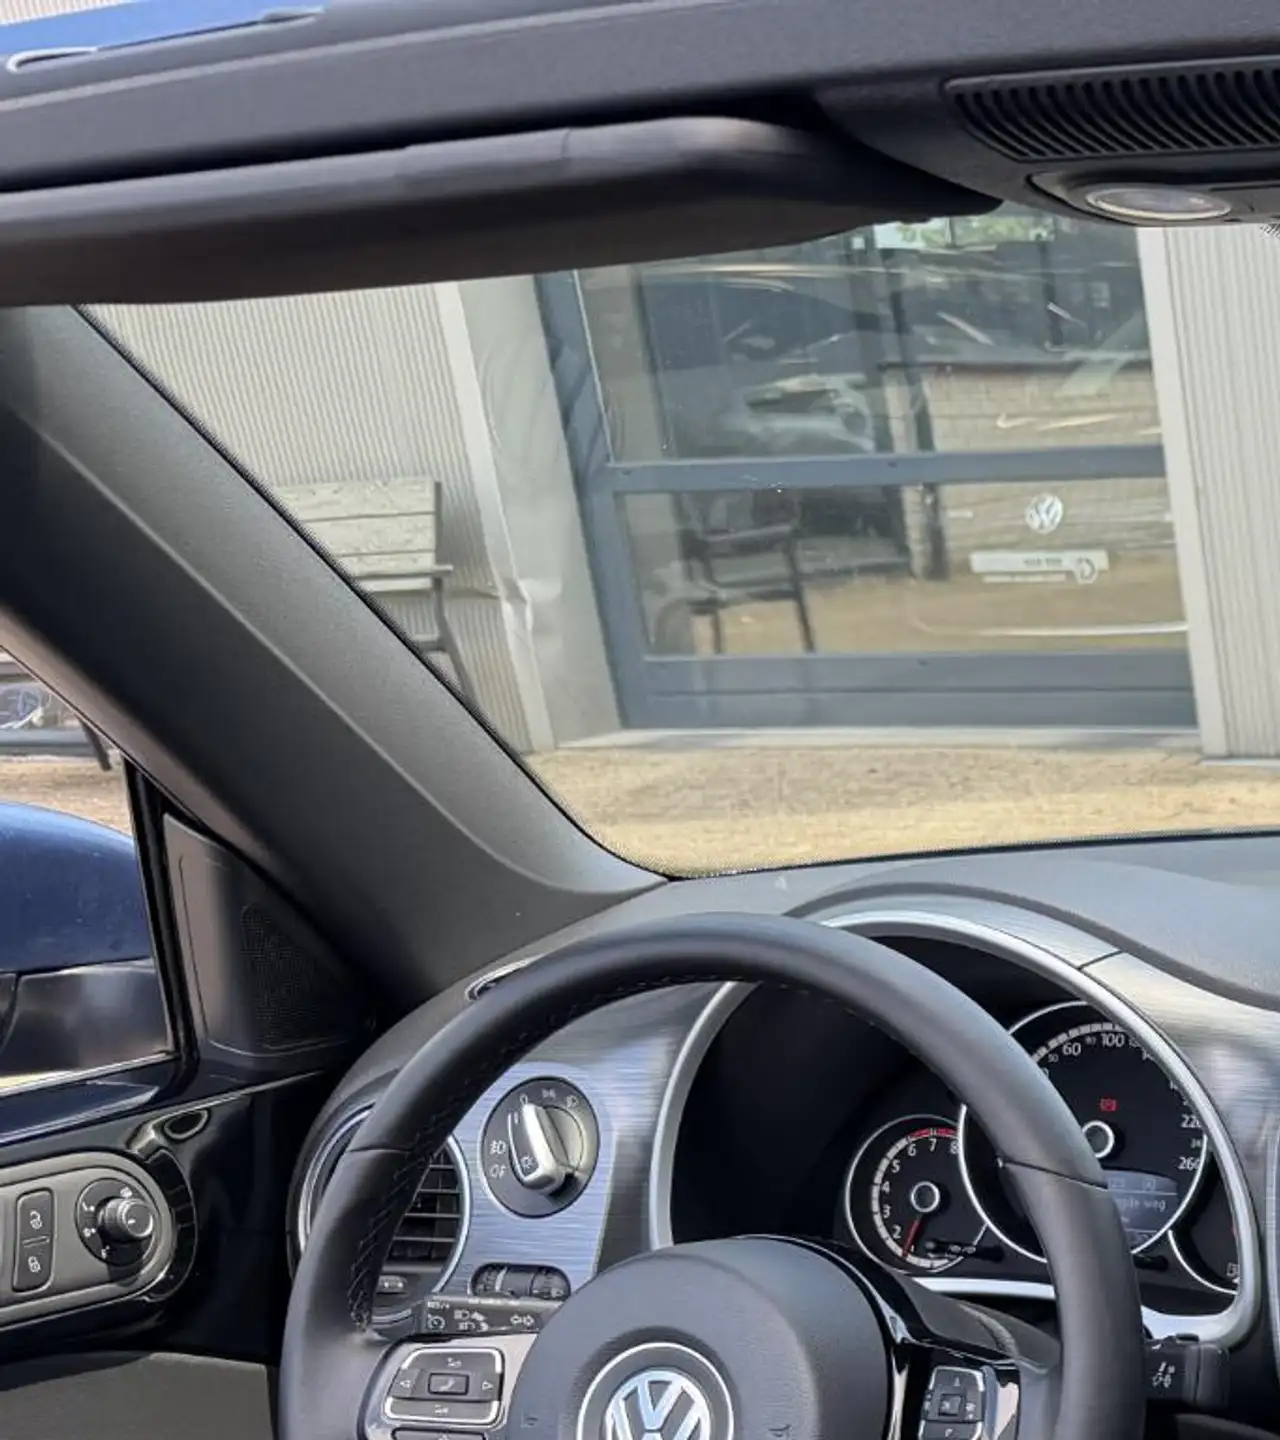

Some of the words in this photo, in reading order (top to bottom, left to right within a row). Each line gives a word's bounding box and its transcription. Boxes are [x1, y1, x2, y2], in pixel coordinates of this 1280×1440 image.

[1101, 1033, 1125, 1047] 100
[1062, 1043, 1081, 1056] 60
[908, 1144, 917, 1156] 6
[929, 1138, 937, 1152] 7
[891, 1160, 900, 1173] 5
[882, 1181, 890, 1193] 4
[883, 1205, 891, 1218] 3
[892, 1225, 901, 1239] 2
